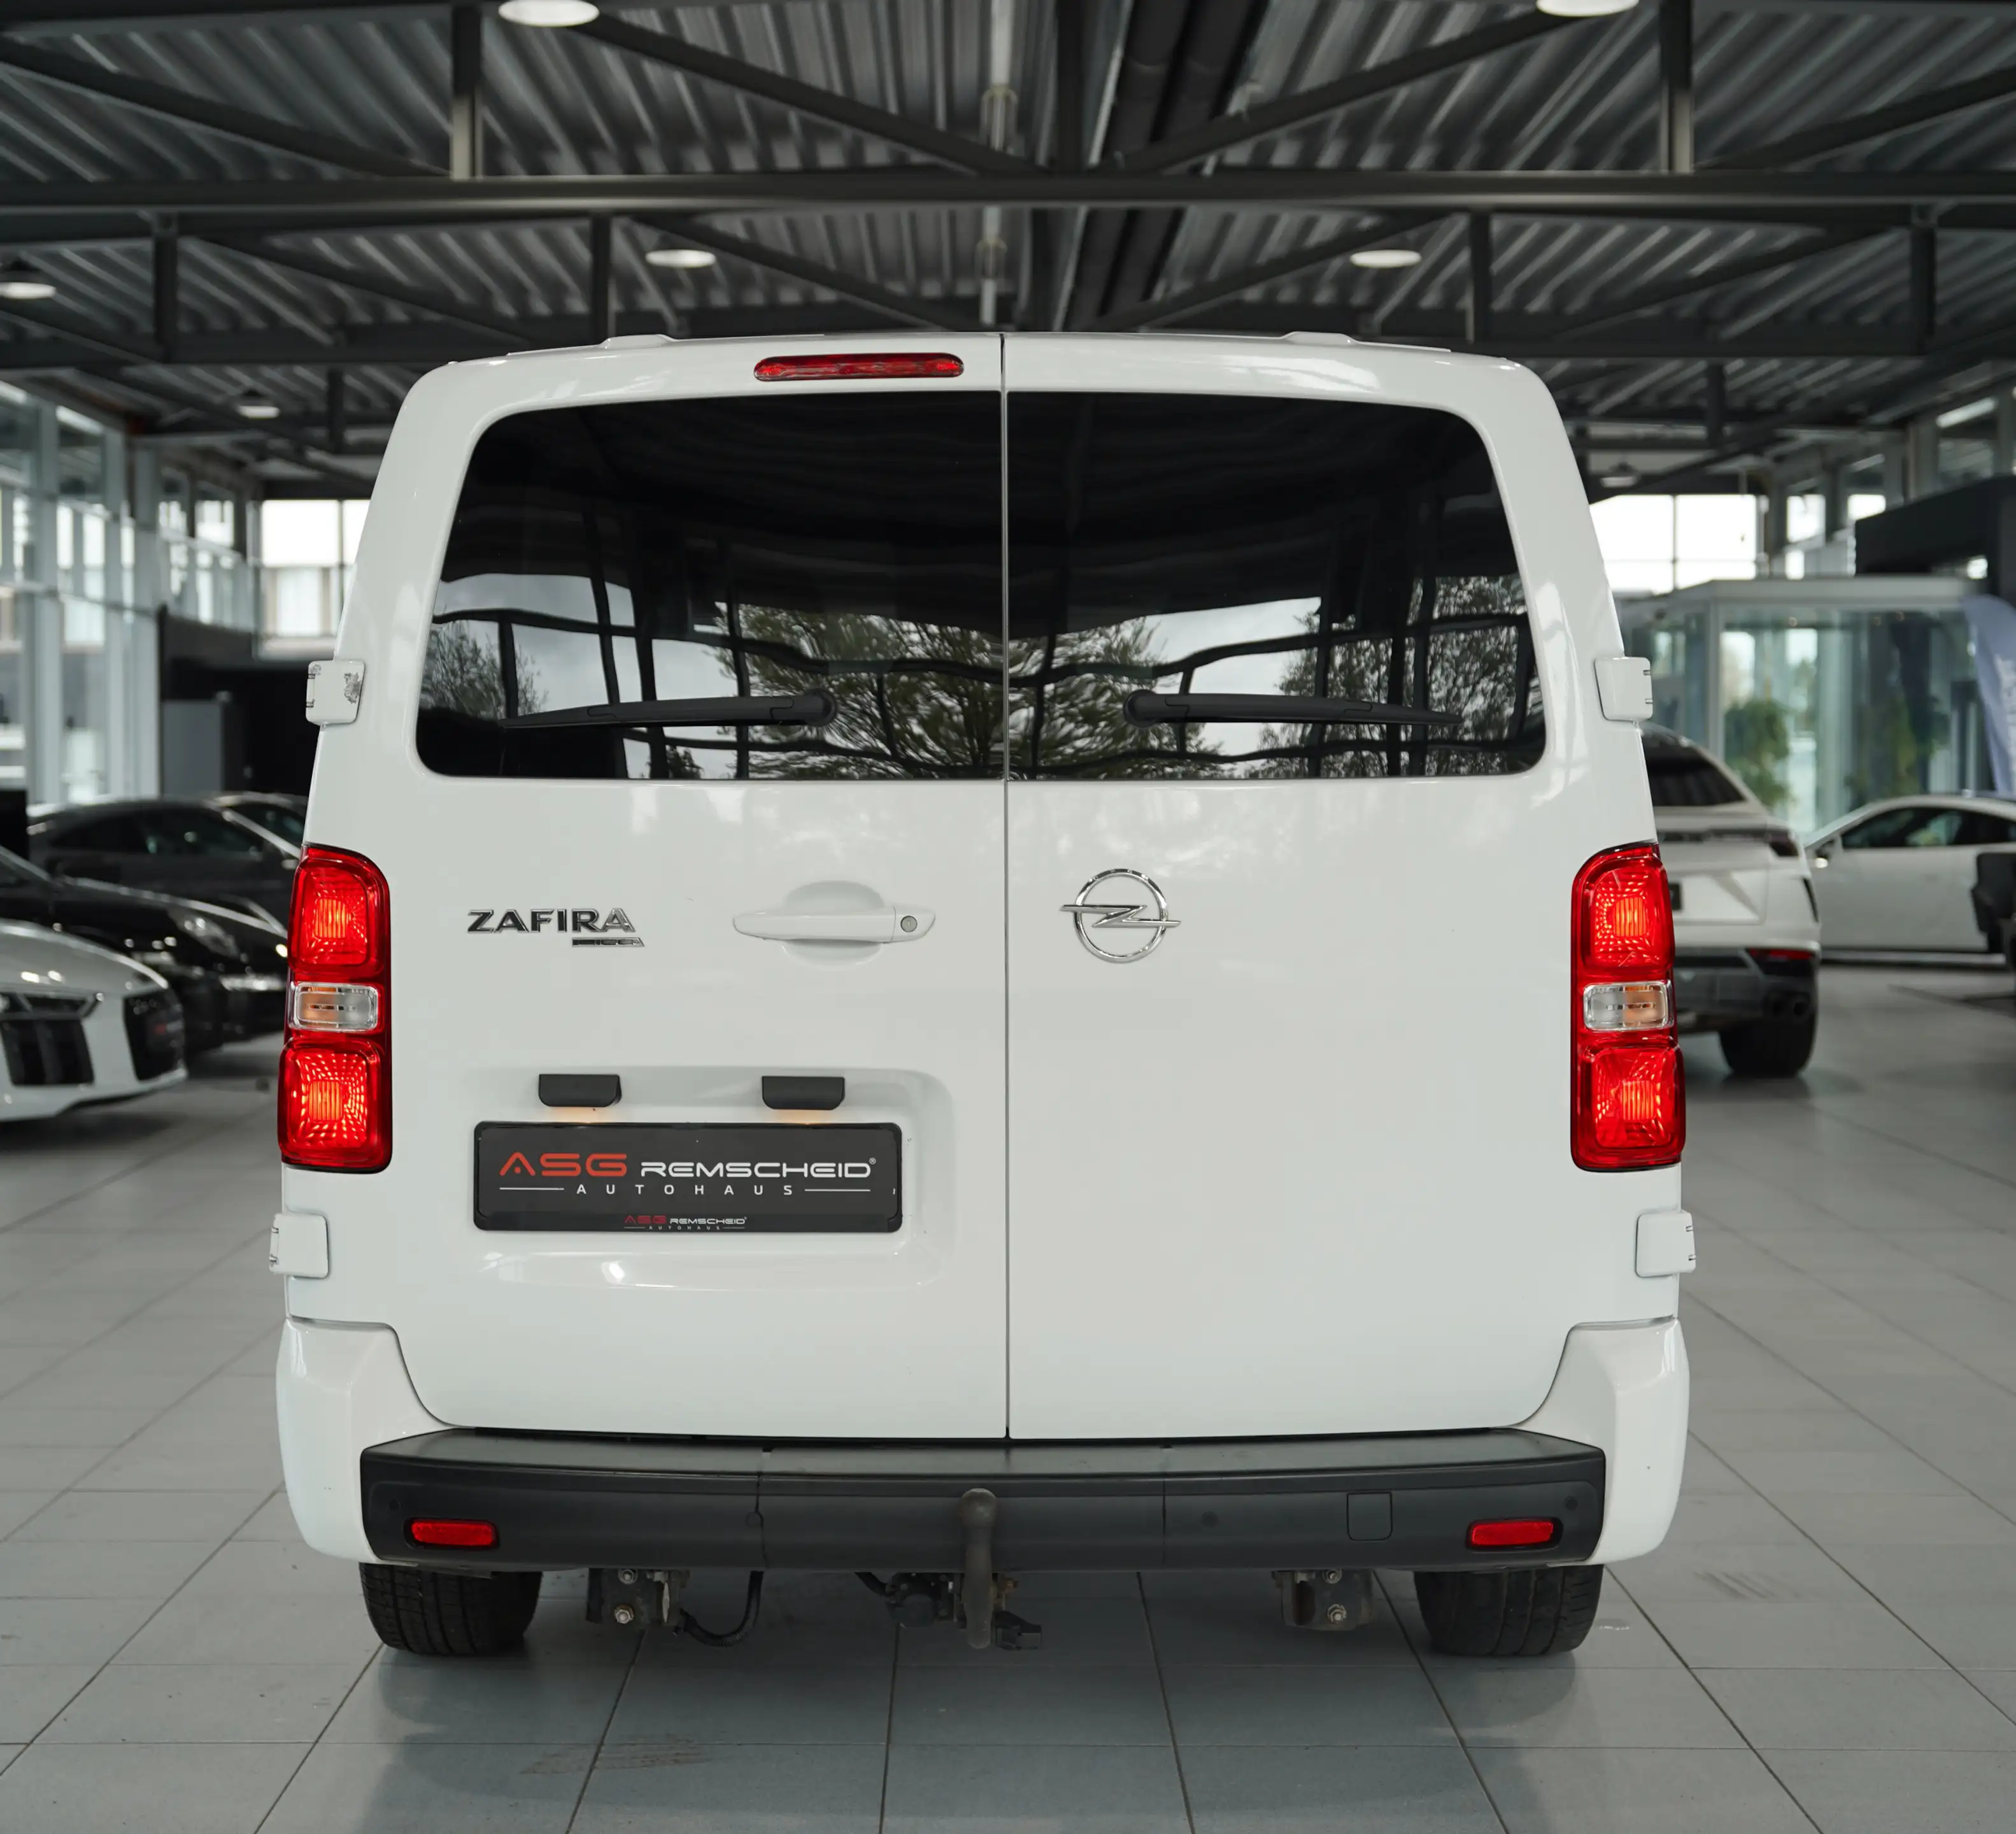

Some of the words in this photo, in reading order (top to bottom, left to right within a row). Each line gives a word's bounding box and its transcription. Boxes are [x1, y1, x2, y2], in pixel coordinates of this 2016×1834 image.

[467, 908, 636, 934] ZAFIRA
[499, 1151, 628, 1177] ASG
[576, 1184, 793, 1196] AUTOHAUS
[623, 1215, 667, 1224] ASG
